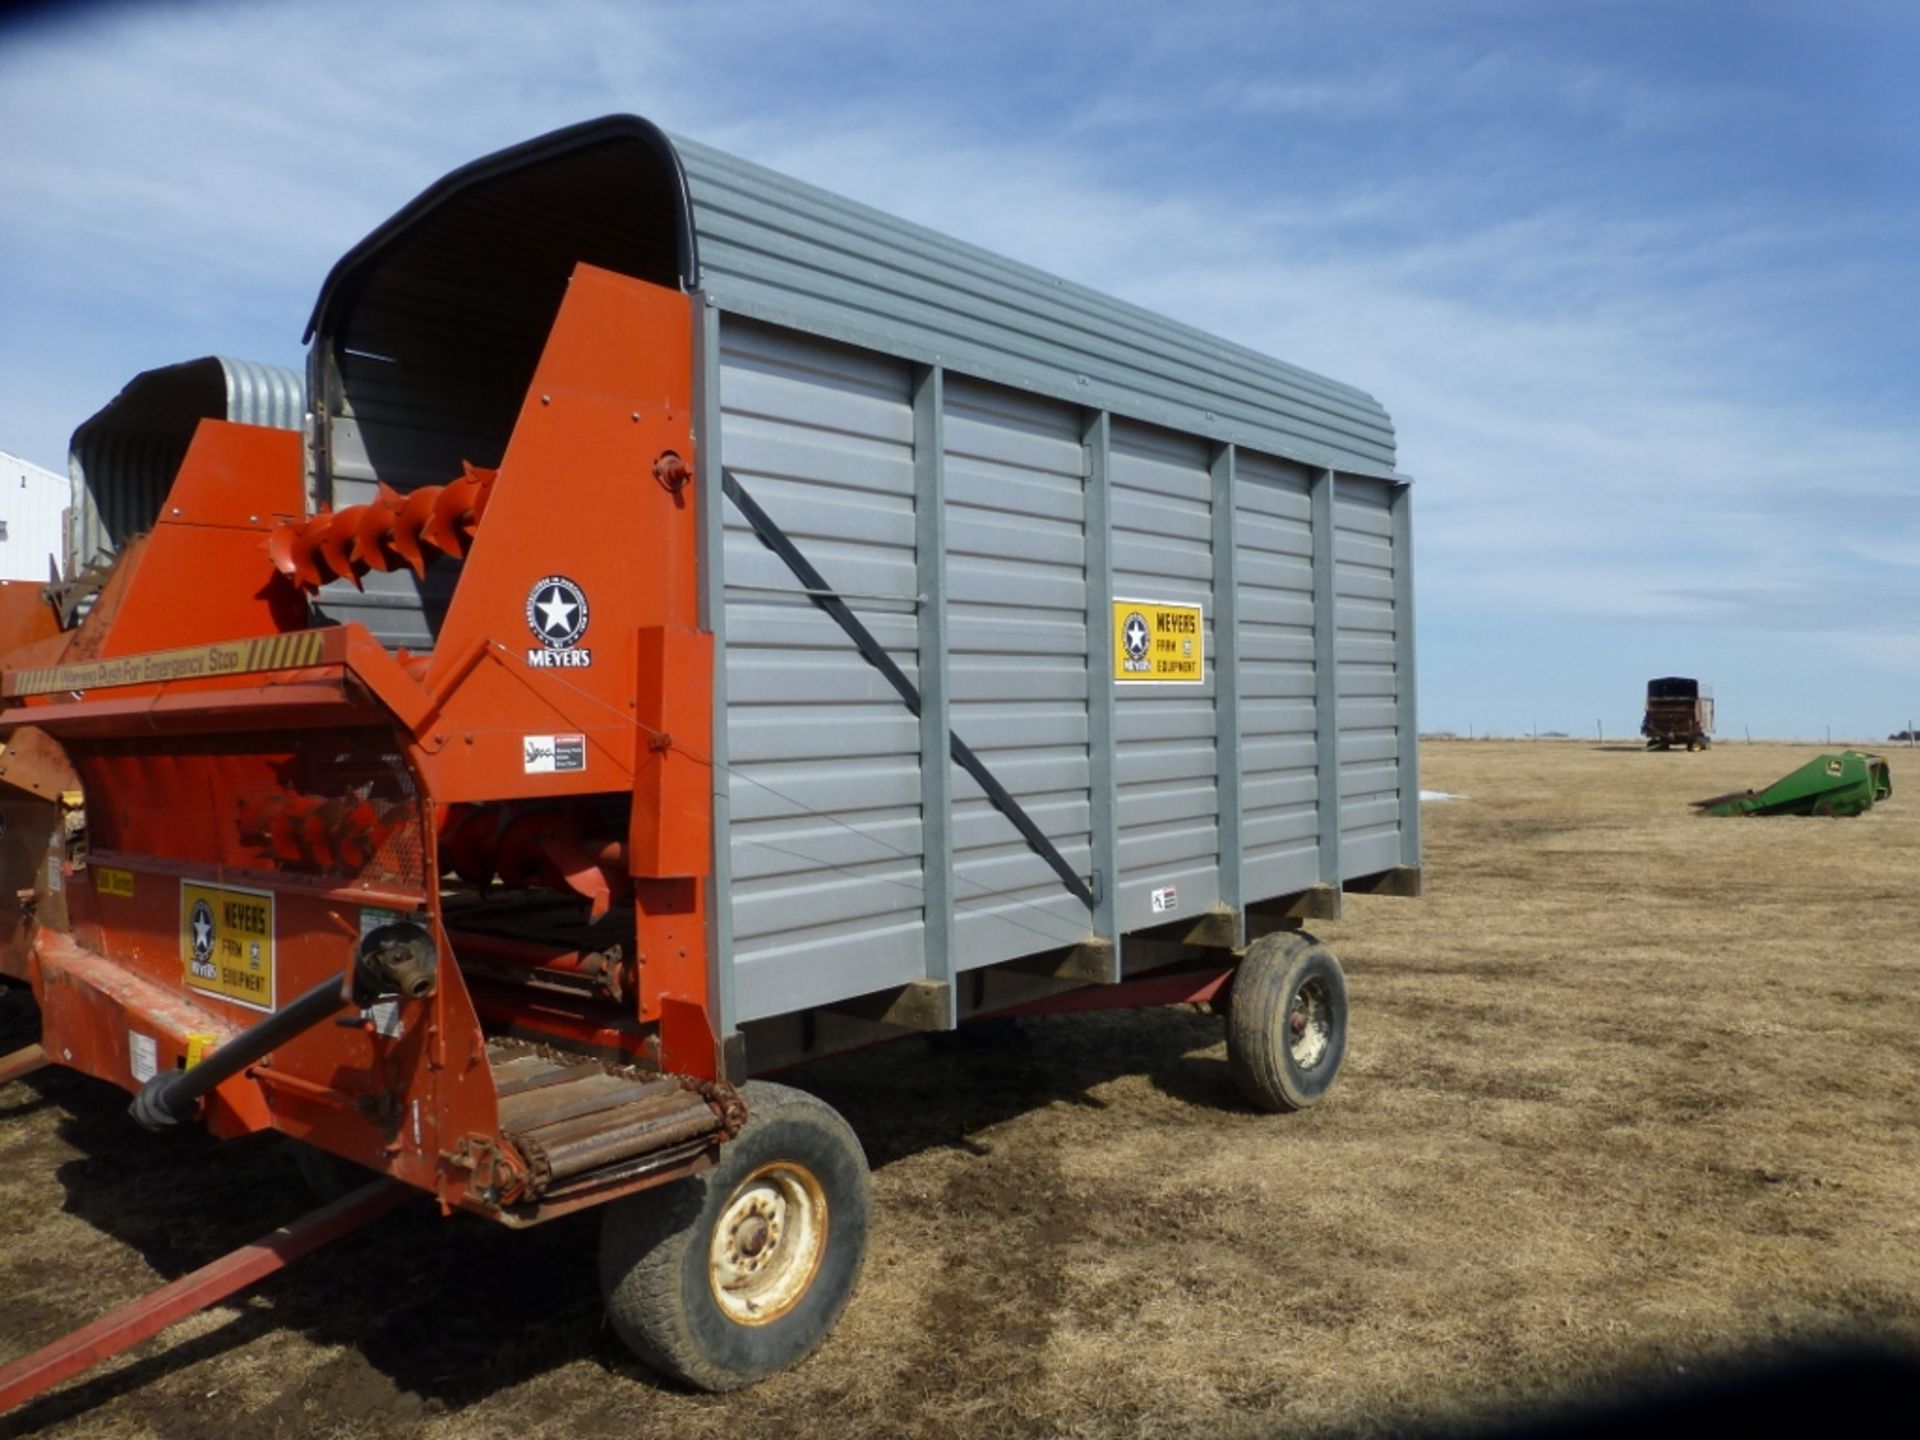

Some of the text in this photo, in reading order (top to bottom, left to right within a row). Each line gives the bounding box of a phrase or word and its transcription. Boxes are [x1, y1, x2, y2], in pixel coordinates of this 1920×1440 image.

[123, 659, 141, 681] For
[144, 654, 205, 680] Emergency
[208, 646, 240, 673] Stop
